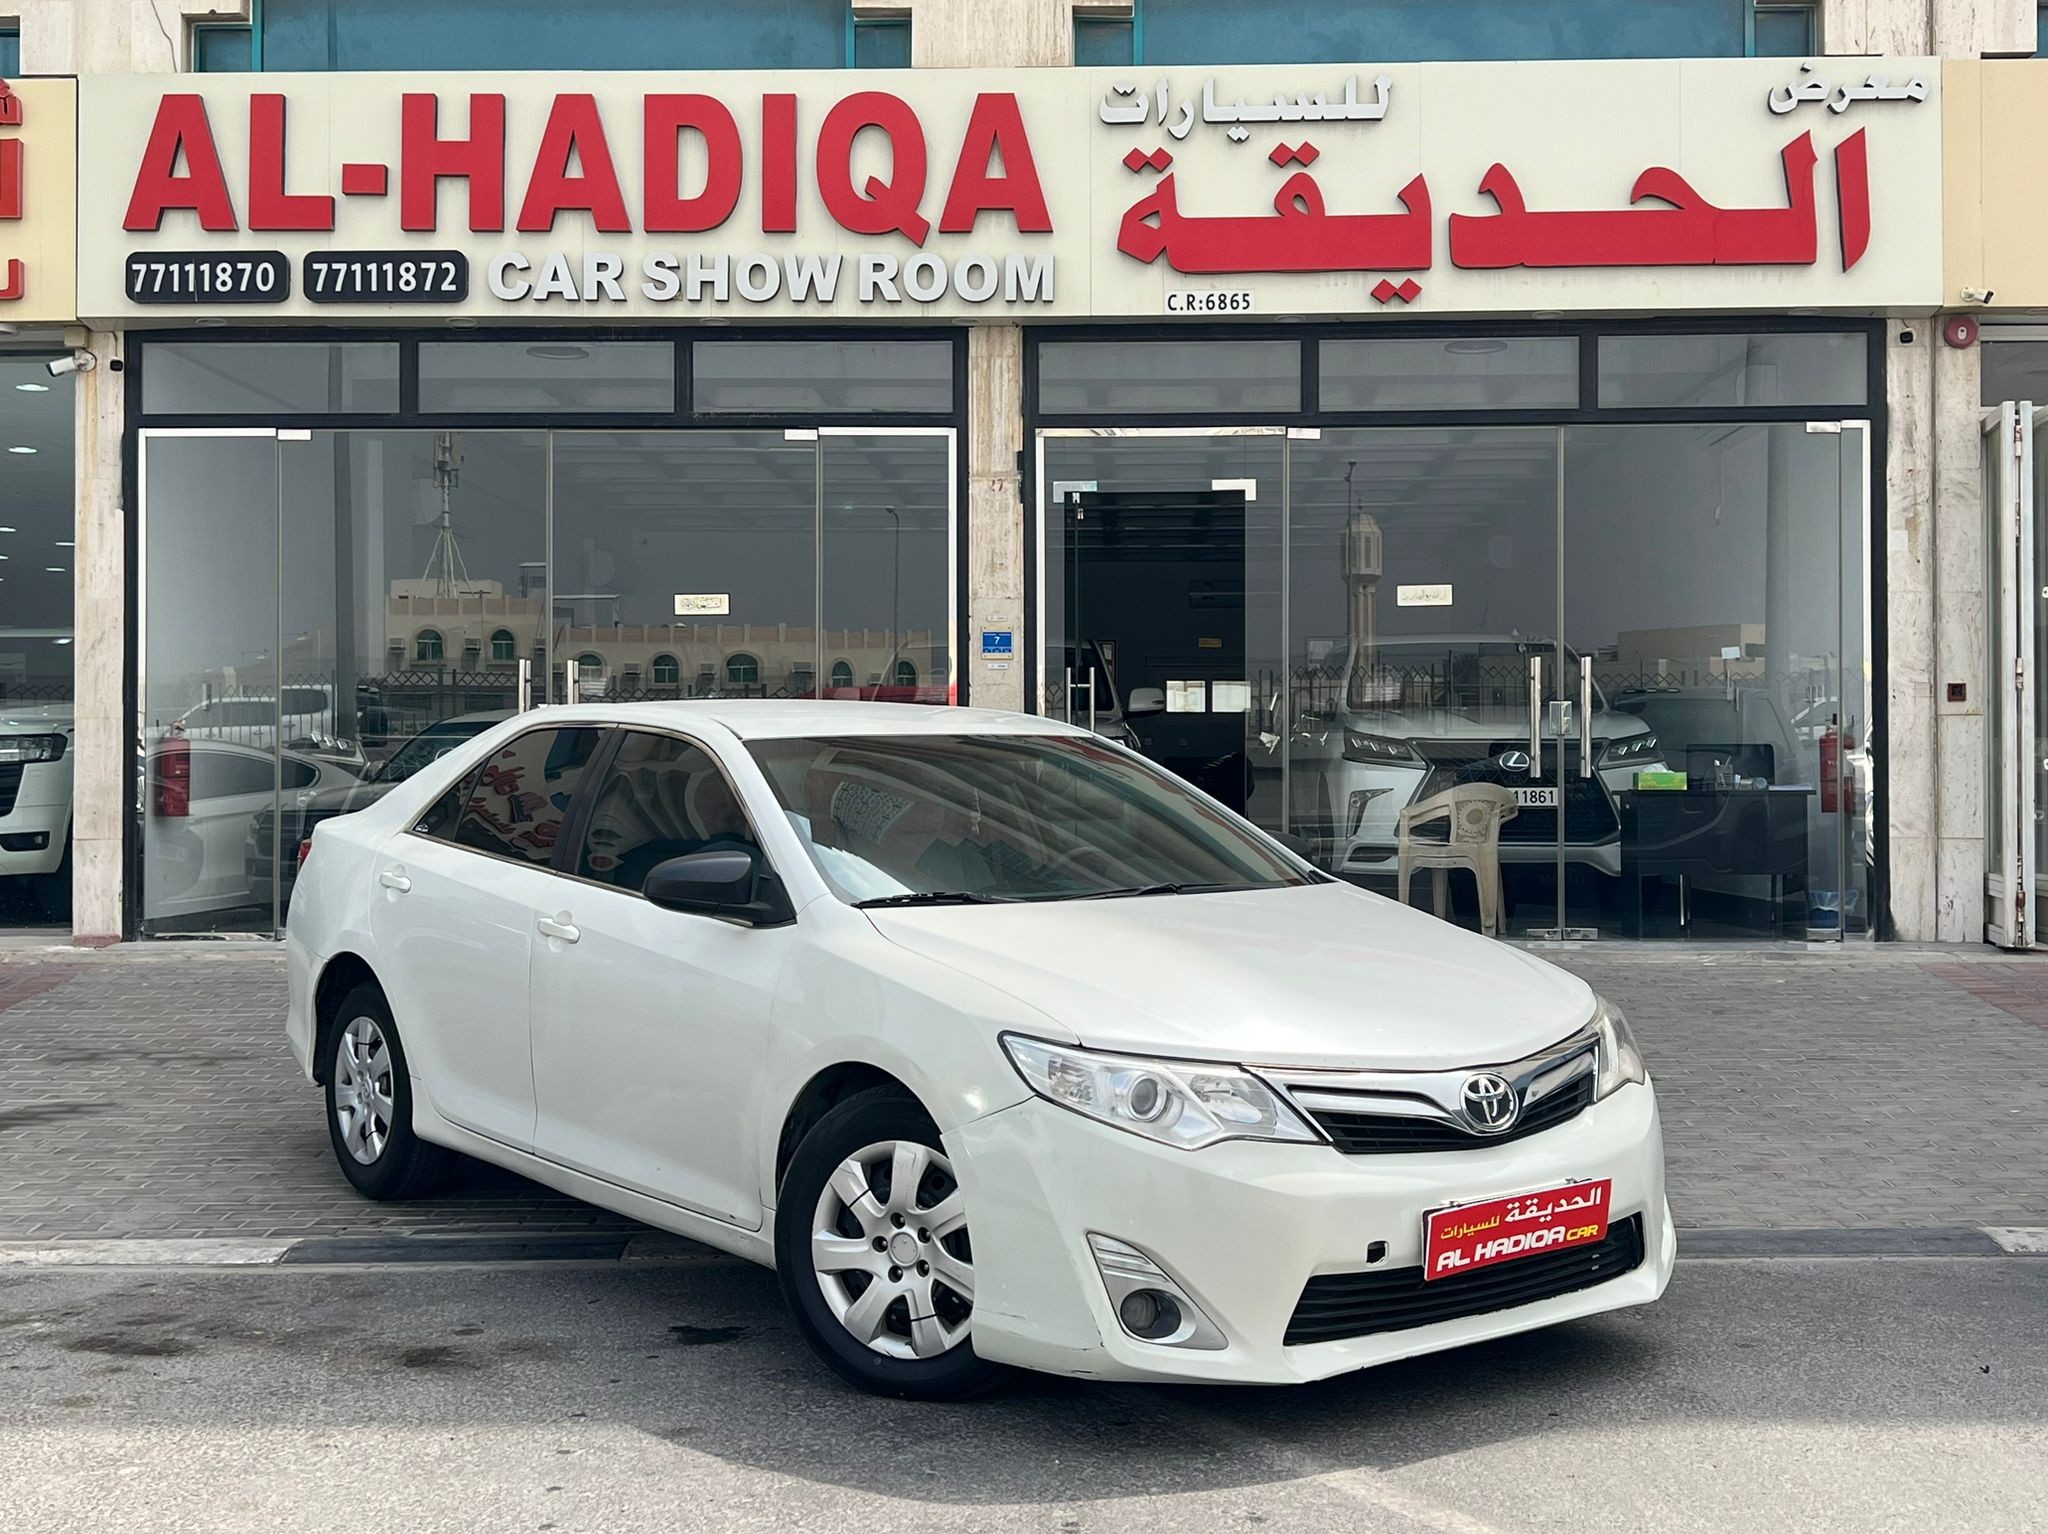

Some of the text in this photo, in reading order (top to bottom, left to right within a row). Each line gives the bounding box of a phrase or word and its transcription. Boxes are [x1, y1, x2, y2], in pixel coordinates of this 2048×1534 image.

[1099, 73, 1393, 143] للسيارات
[1767, 62, 1929, 115] معرض
[122, 92, 1053, 246] AL-HADIQA
[1117, 127, 1871, 304] الحديقة
[131, 261, 457, 293] 77111870 77111872
[487, 251, 1056, 303] CAR SHOW ROOM
[1167, 293, 1251, 313] C.R:6865
[994, 636, 1001, 645] 7
[1440, 1186, 1602, 1240] الحديقة للسيارات
[1436, 1224, 1599, 1272] AL HADIQA CAR
